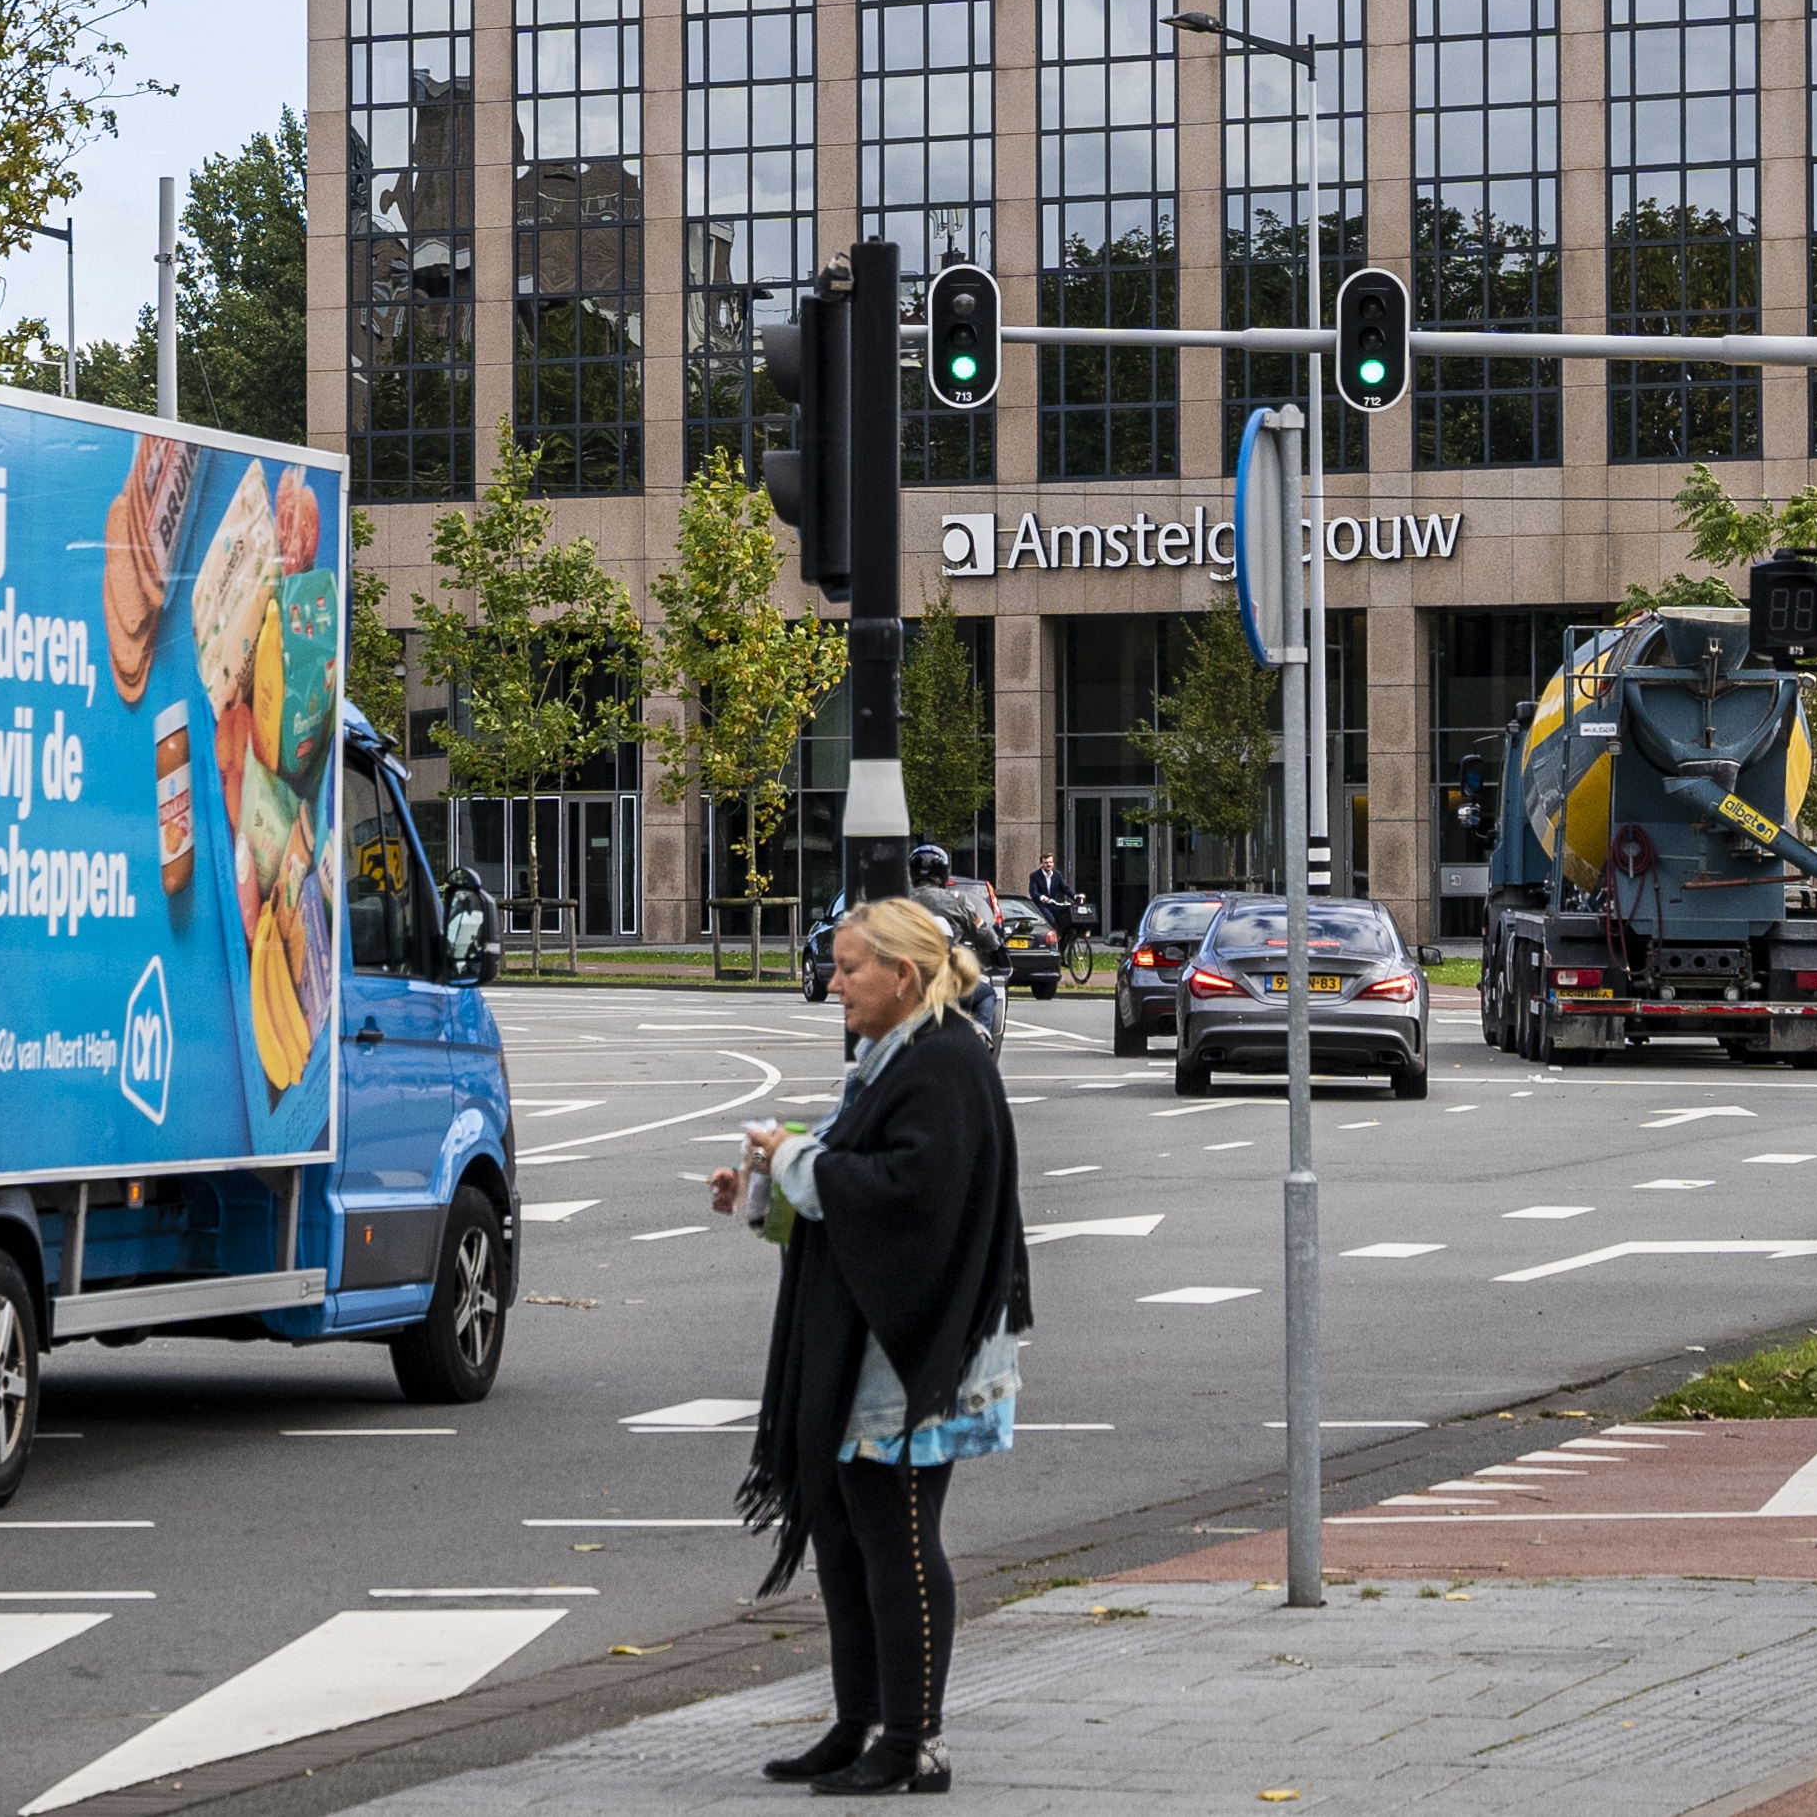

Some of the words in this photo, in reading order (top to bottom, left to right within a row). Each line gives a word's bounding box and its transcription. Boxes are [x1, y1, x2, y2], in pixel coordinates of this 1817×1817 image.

[954, 391, 973, 402] 713
[1363, 396, 1382, 407] 712
[1007, 505, 1463, 582] Amstelgouw
[42, 710, 83, 802] de
[1724, 798, 1775, 842] albeton
[17, 1040, 42, 1071] van
[43, 1030, 84, 1070] Albert
[85, 1029, 117, 1076] Heijn
